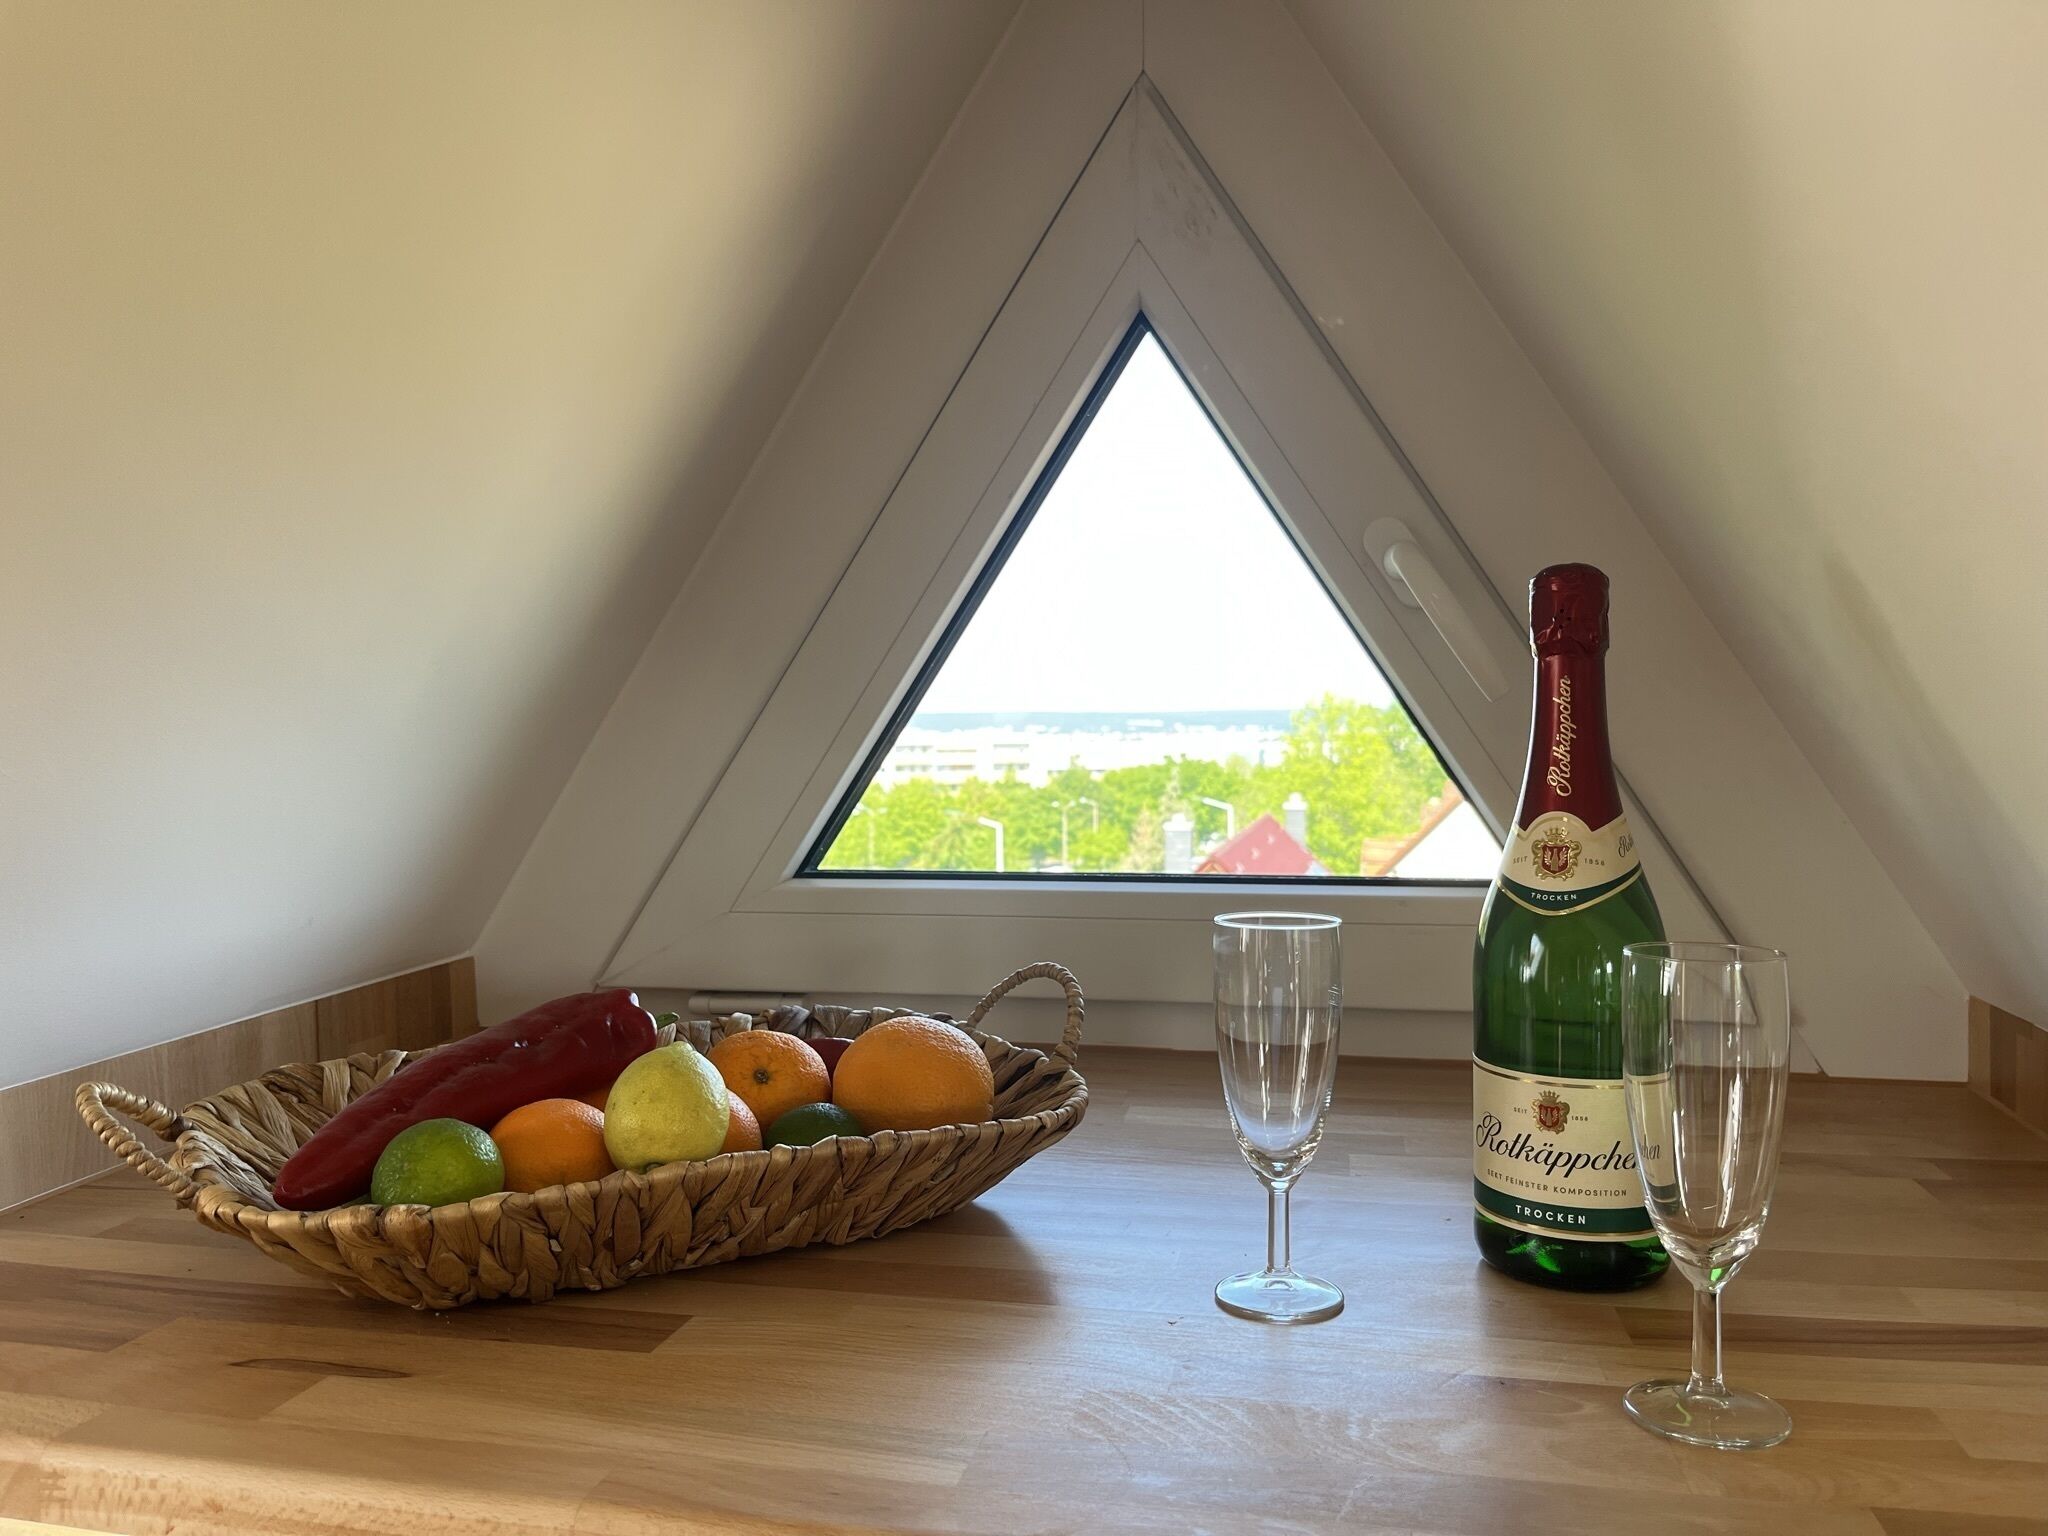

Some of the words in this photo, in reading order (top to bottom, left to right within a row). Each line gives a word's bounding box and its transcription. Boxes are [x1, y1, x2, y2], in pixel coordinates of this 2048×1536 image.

[1546, 674, 1577, 797] Rotkäppchen
[1530, 892, 1578, 902] TROCKEN
[1513, 1106, 1528, 1115] SEIT
[1487, 1168, 1503, 1182] SEKT
[1505, 1175, 1549, 1192] FEINSTER
[1553, 1186, 1628, 1197] KOMPOSITION
[1515, 1204, 1587, 1225] TROCKEN
